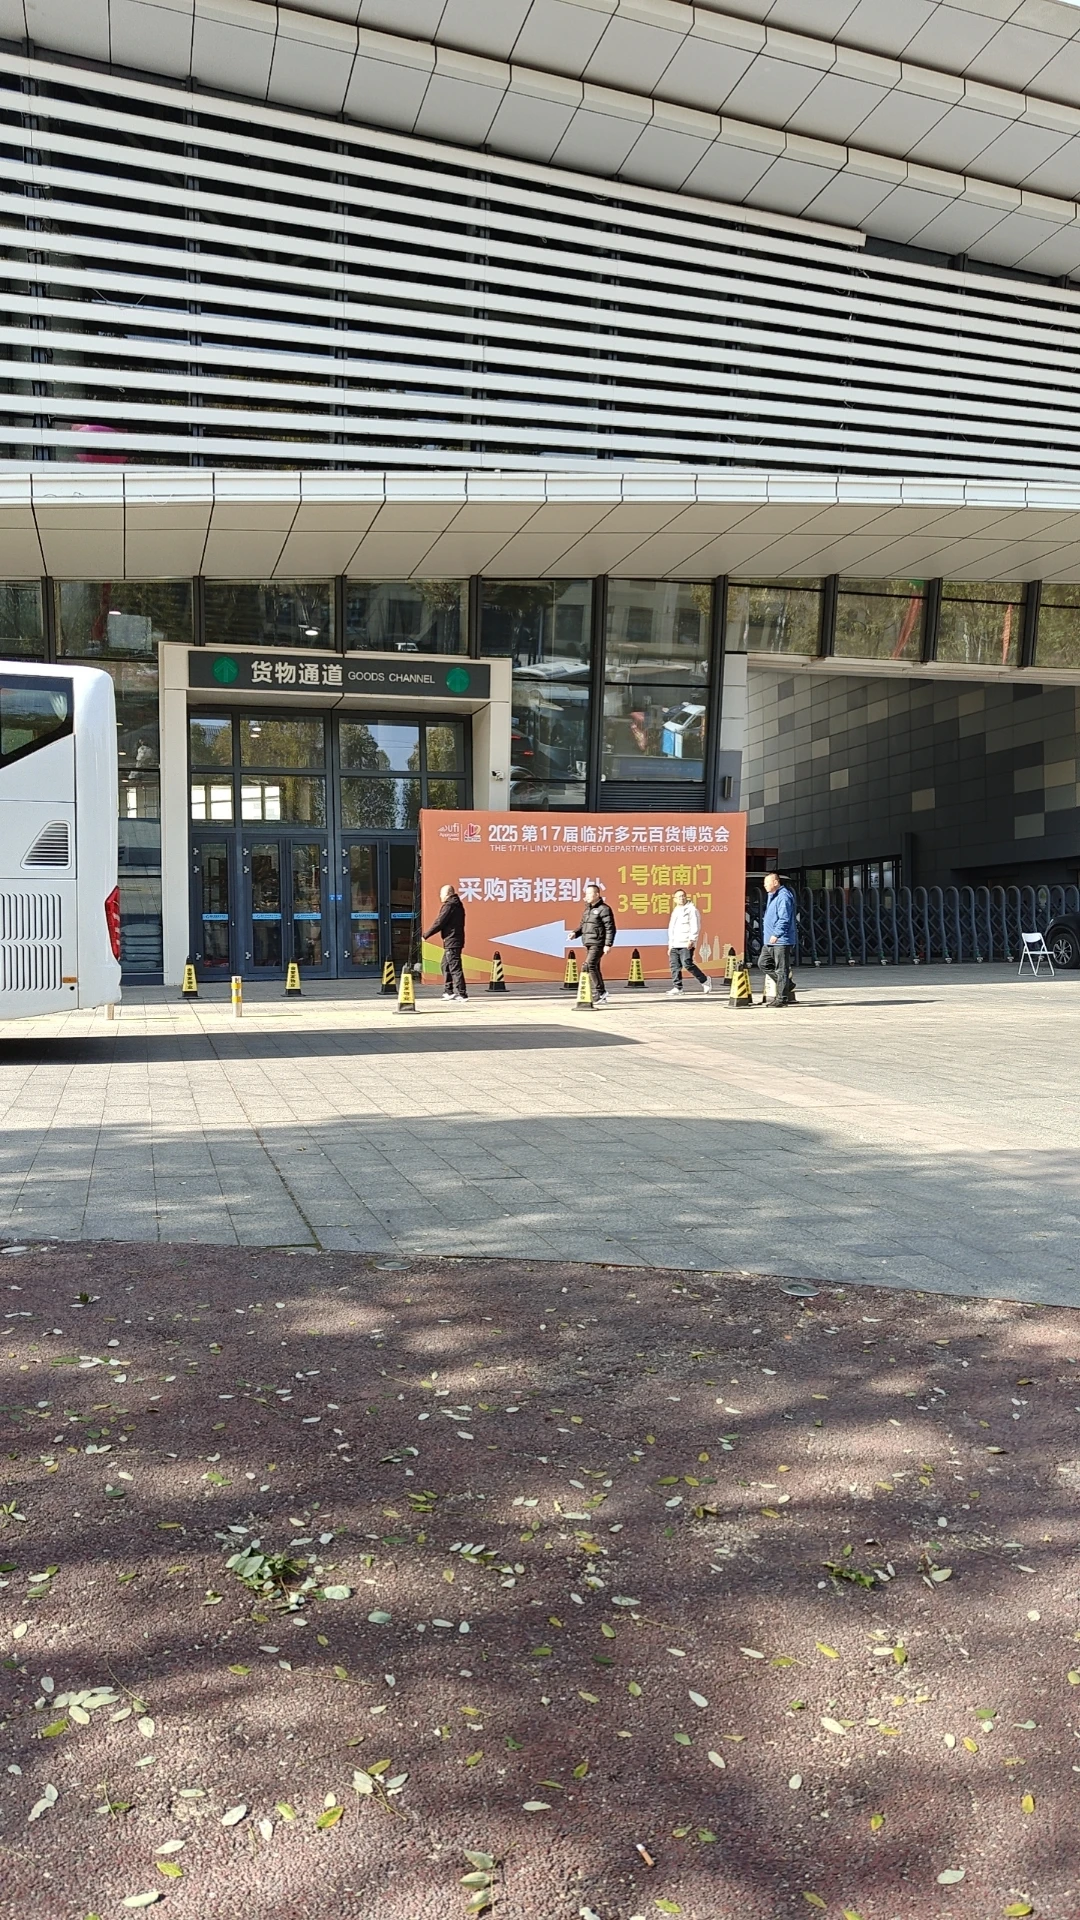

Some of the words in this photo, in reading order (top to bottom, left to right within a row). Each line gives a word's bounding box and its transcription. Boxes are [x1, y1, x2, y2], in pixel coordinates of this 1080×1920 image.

[251, 660, 344, 686] 货物通道
[348, 671, 385, 682] GOODS
[388, 673, 436, 684] CHANNEL
[488, 824, 518, 842] 2025
[521, 824, 730, 843] 第17届临沂多元百货博览会
[490, 844, 507, 852] THE
[509, 844, 528, 852] 17TH
[553, 845, 603, 853] DIVERSIFIED
[604, 845, 657, 853] DEPARTMENT
[659, 845, 686, 853] STORE
[617, 864, 712, 886] 1号馆南门
